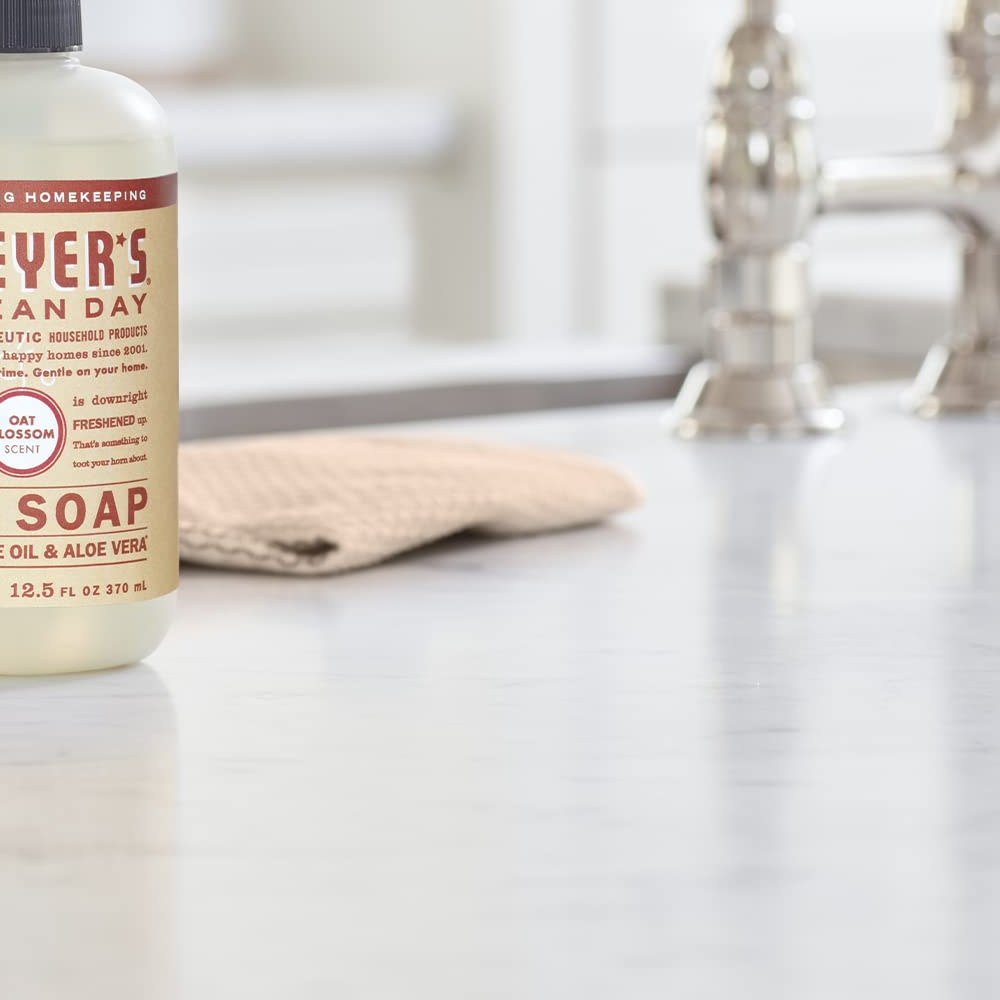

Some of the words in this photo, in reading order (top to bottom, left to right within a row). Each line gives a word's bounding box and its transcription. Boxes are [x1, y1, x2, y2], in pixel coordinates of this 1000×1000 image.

[25, 189, 147, 203] HOMEKEEPING
[85, 293, 147, 318] DAY
[49, 330, 104, 343] HOUSEHOLD
[109, 325, 148, 340] PRODUCTS
[2, 350, 43, 363] happy
[47, 350, 89, 360] homes
[91, 348, 121, 358] since
[123, 344, 148, 355] 2001.
[32, 367, 73, 377] Gentle
[76, 368, 91, 376] on
[94, 366, 119, 378] your
[121, 362, 148, 372] home.
[72, 396, 85, 407] is
[91, 389, 148, 405] downright
[8, 415, 36, 426] OAT
[72, 414, 135, 430] FRESHENED
[4, 444, 41, 455] SCENT
[72, 440, 99, 449] That's
[101, 436, 140, 448] something
[72, 460, 90, 468] toot
[90, 459, 110, 469] your
[110, 456, 128, 466] horn
[15, 486, 148, 532] SOAP
[9, 544, 39, 559] OIL
[43, 545, 58, 558] &
[63, 542, 108, 558] ALOE
[9, 583, 54, 598] 12.5
[60, 586, 76, 597] FL
[82, 585, 100, 596] OZ
[106, 582, 129, 595] 370
[134, 580, 147, 592] mL
